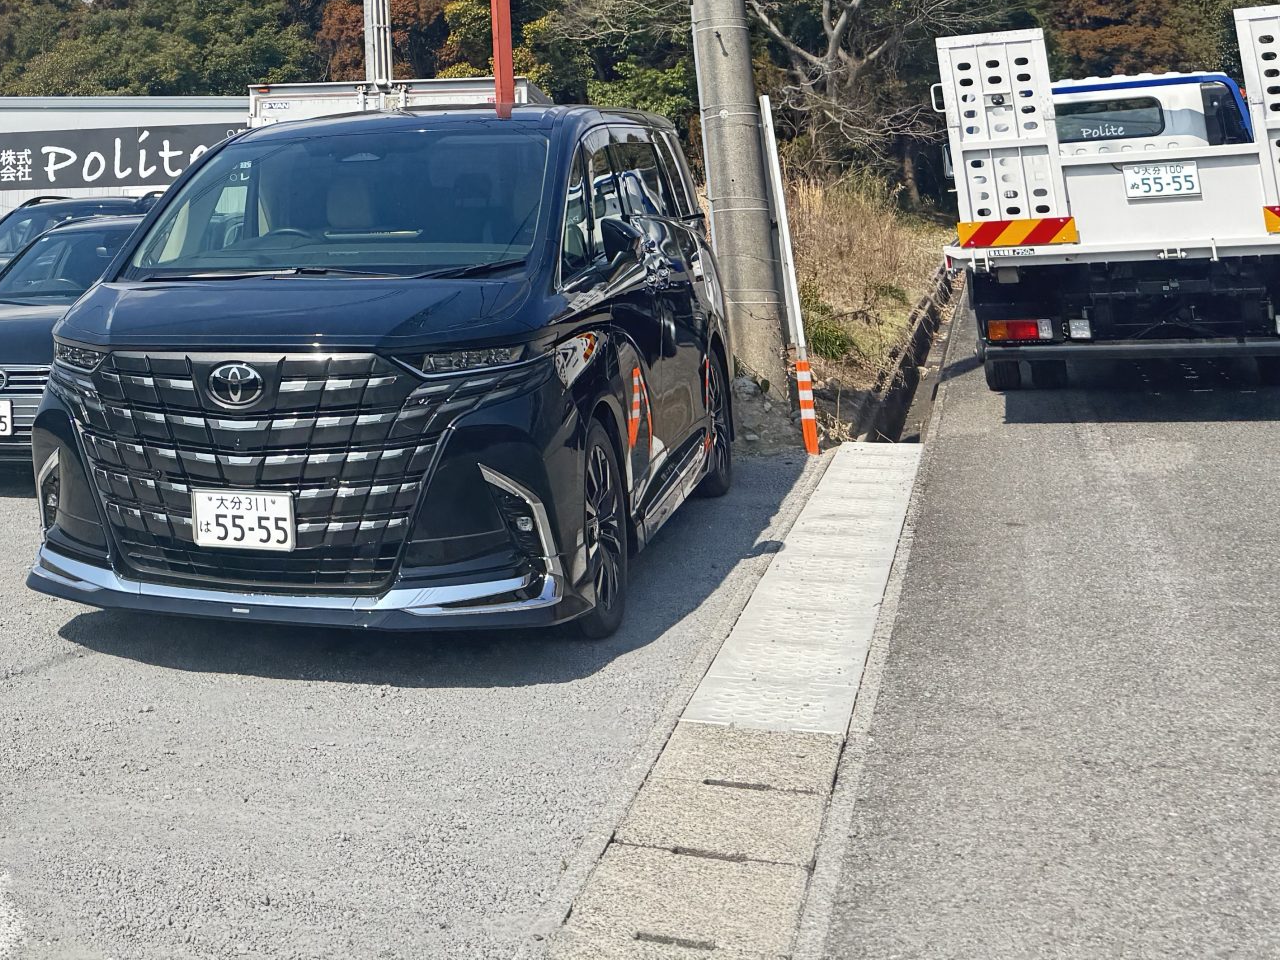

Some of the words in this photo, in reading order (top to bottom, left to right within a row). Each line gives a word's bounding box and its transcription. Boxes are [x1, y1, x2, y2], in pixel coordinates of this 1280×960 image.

[1081, 123, 1125, 138] Polite
[0, 148, 32, 166] 株式
[0, 165, 32, 182] 会社
[1141, 174, 1195, 193] 55-55
[199, 520, 212, 533] は
[215, 513, 289, 545] 55-55
